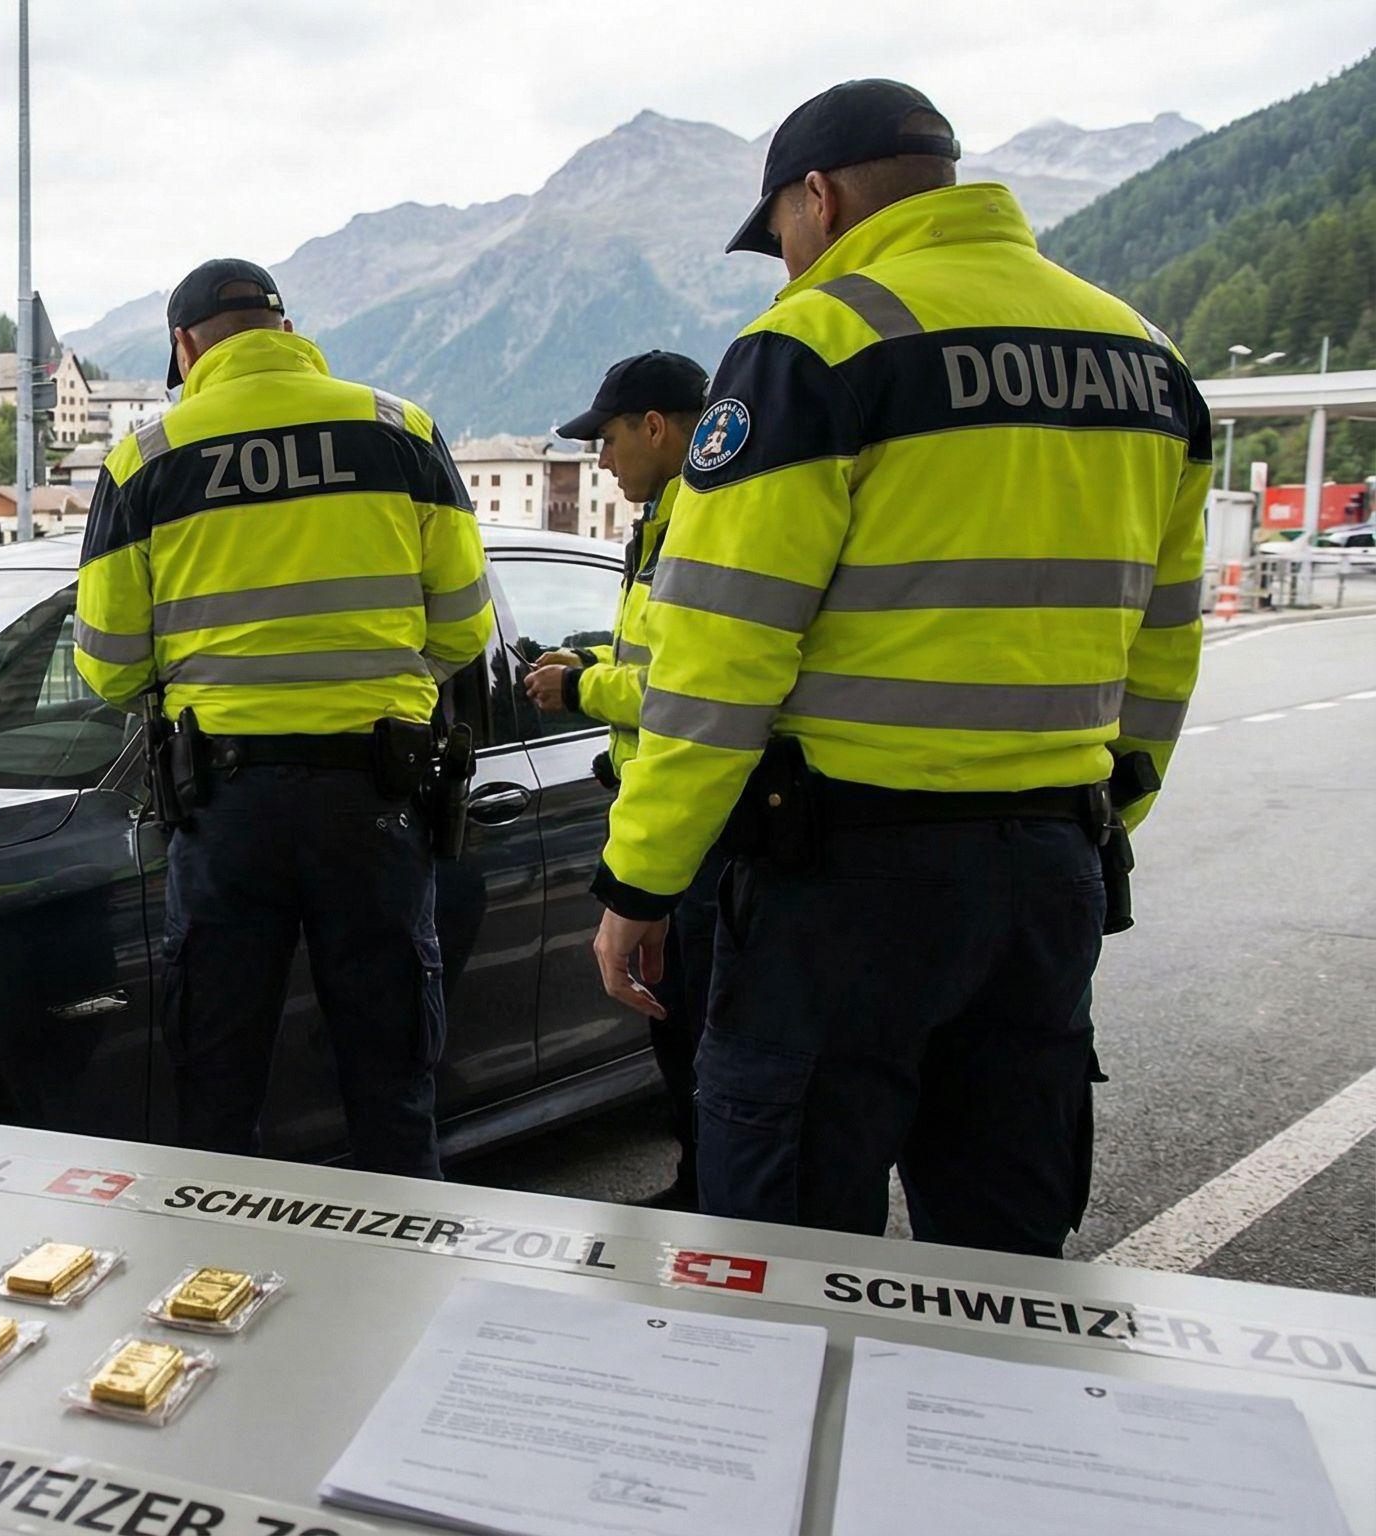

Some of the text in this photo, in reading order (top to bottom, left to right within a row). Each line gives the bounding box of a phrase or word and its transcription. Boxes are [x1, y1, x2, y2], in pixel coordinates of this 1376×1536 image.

[941, 342, 1173, 418] DOUANE
[200, 431, 356, 499] ZOLL
[164, 1185, 617, 1270] SCHWEIZER ZOLL
[823, 1272, 1222, 1355] SCHWEIZER
